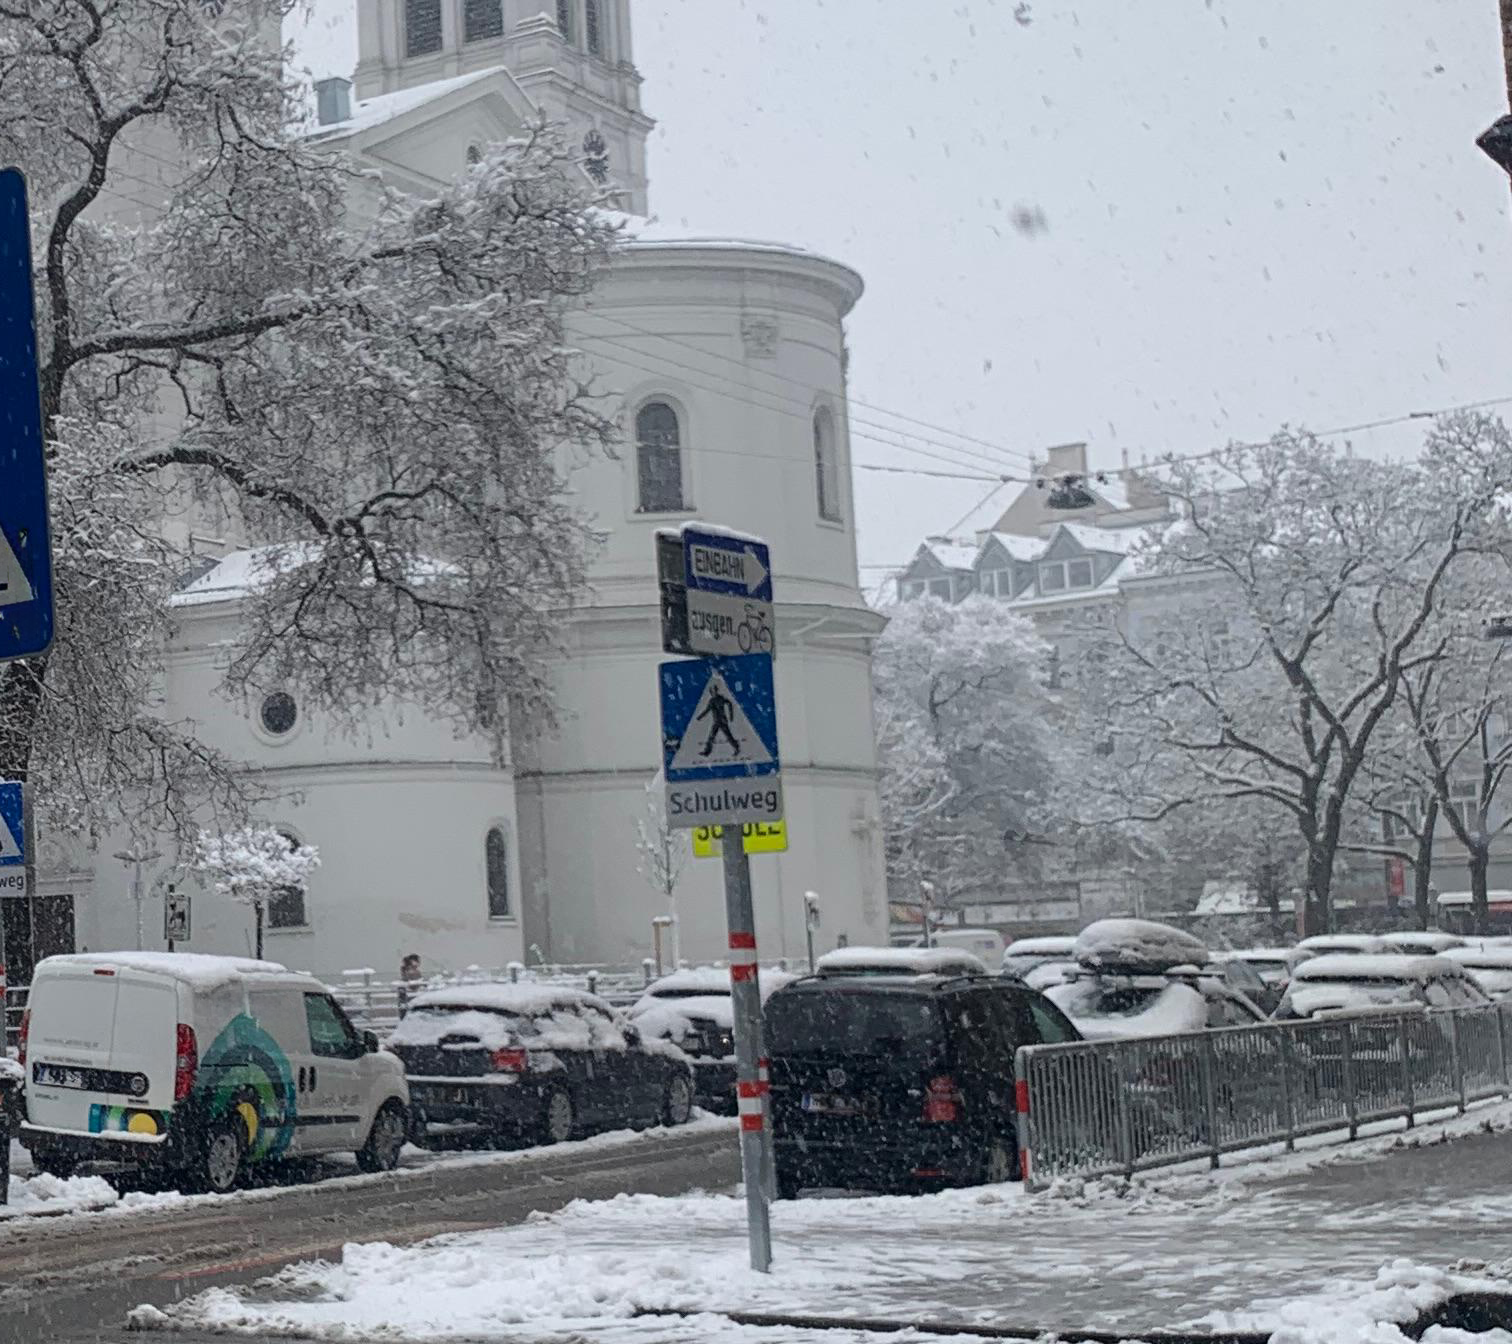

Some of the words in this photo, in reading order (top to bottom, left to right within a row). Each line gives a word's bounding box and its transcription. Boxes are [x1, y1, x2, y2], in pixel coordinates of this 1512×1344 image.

[694, 547, 745, 580] EINBAHN
[691, 610, 737, 641] ausgen.
[670, 789, 778, 815] Schulweg
